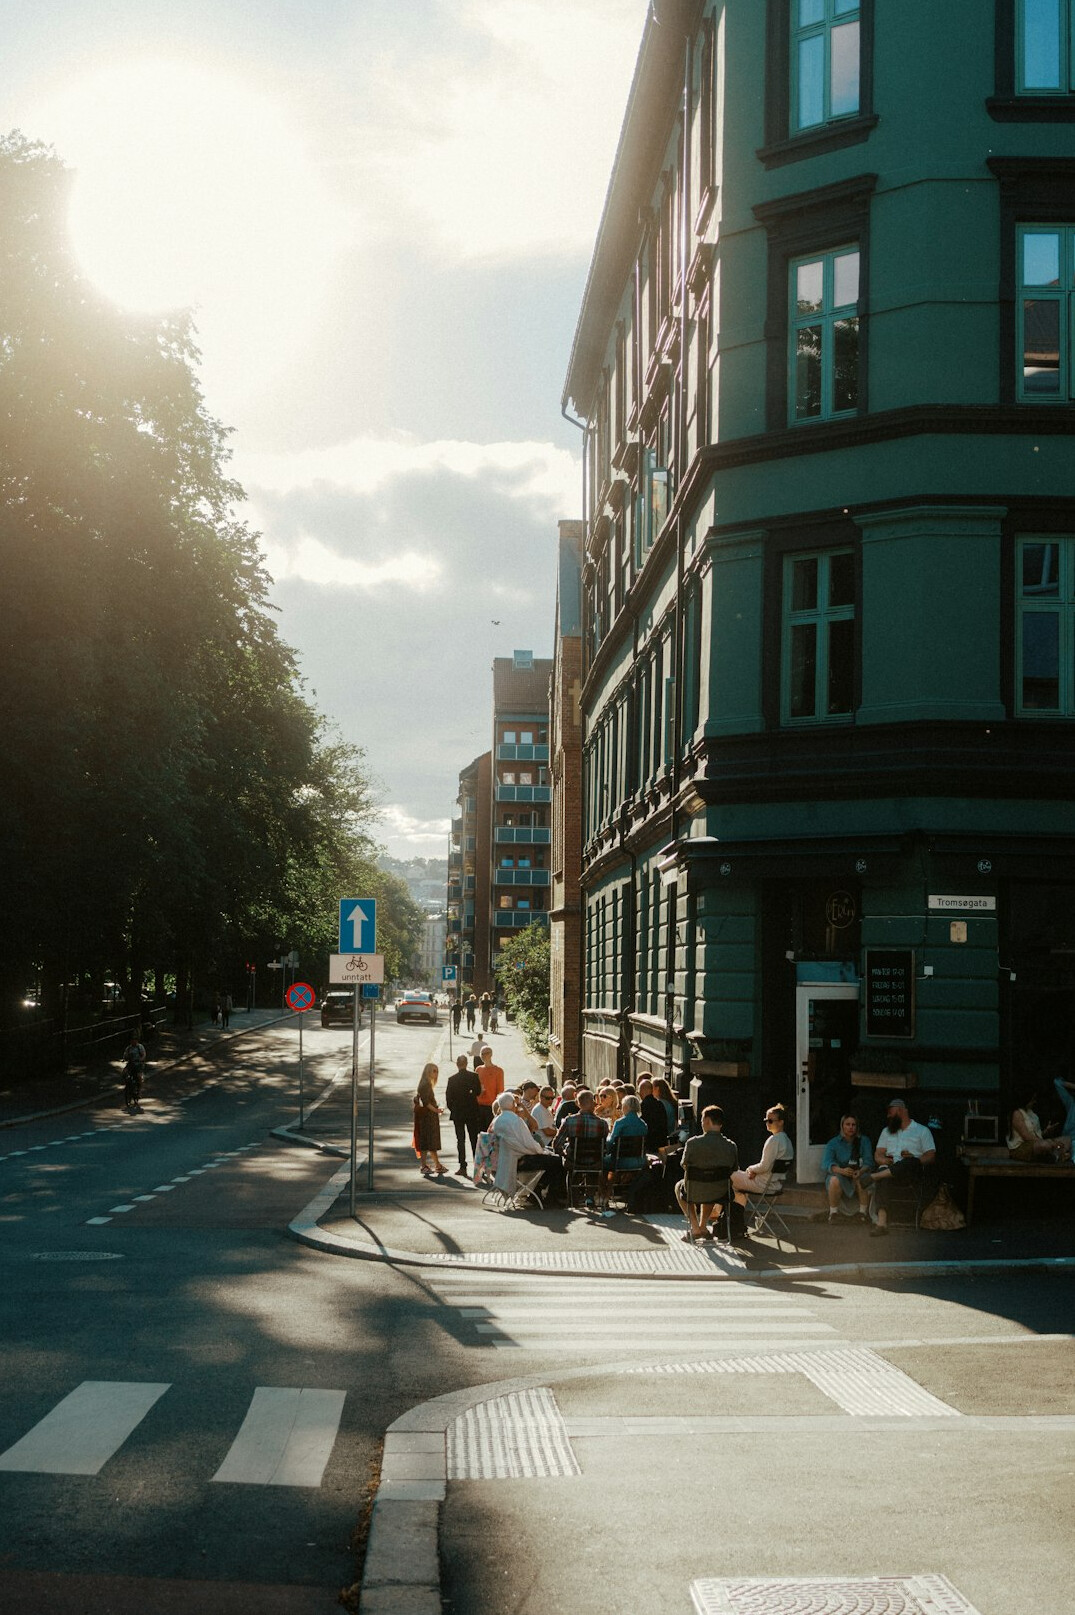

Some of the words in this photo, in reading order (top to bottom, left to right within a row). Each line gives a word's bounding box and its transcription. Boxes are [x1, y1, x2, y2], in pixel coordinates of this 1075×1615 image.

[937, 898, 988, 909] Tromsøgata
[341, 974, 372, 982] unntatt
[445, 967, 453, 979] P
